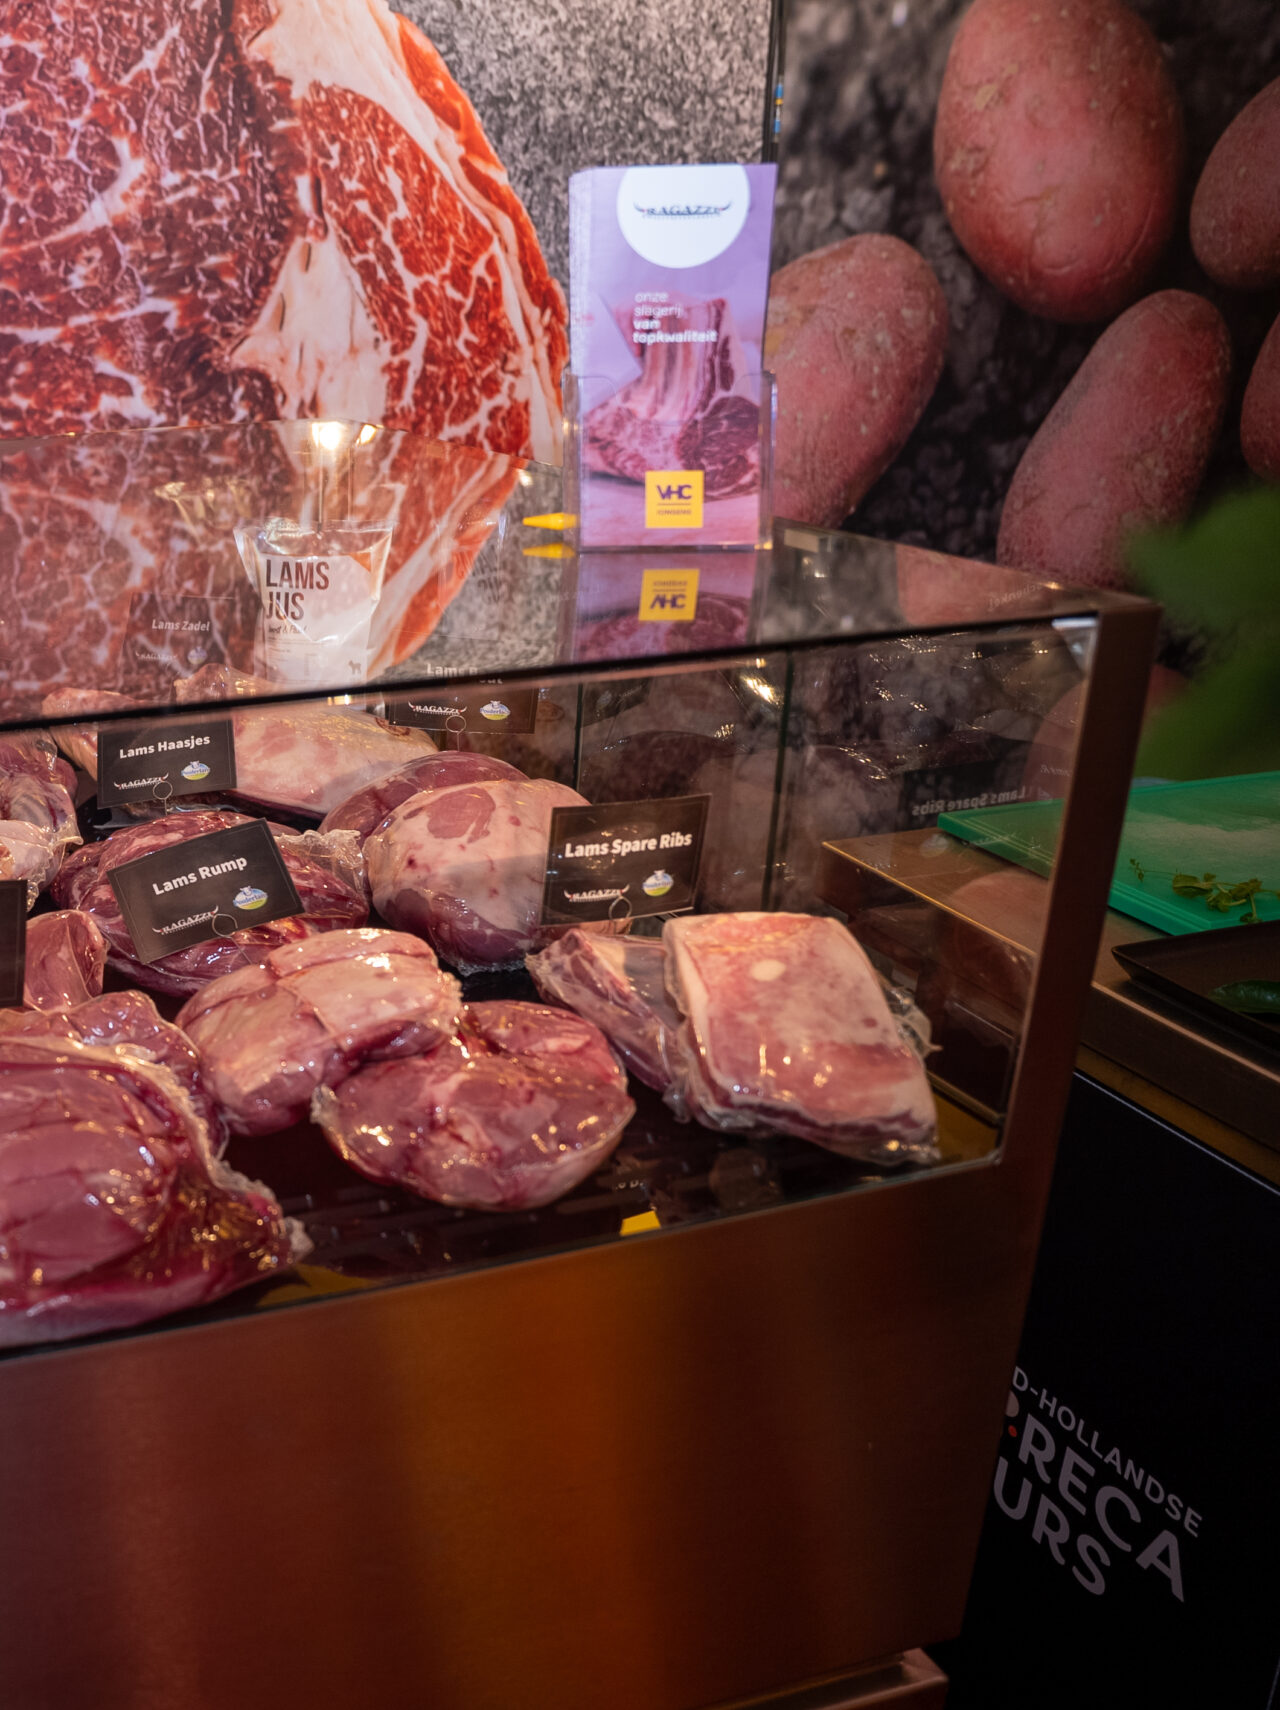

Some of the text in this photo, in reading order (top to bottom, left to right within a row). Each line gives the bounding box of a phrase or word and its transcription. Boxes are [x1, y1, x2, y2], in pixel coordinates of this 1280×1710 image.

[634, 292, 668, 303] onze
[634, 304, 683, 319] slagerij
[633, 319, 661, 330] van
[632, 329, 718, 346] topkwaliteit
[656, 484, 693, 500] VHC
[265, 558, 330, 590] LAMS
[265, 591, 305, 621] JUS
[152, 619, 210, 632] Lams Zadel
[119, 735, 211, 759] Lams Haasjes
[564, 831, 693, 858] Lams Spare Ribs
[152, 857, 248, 896] Lams Rump
